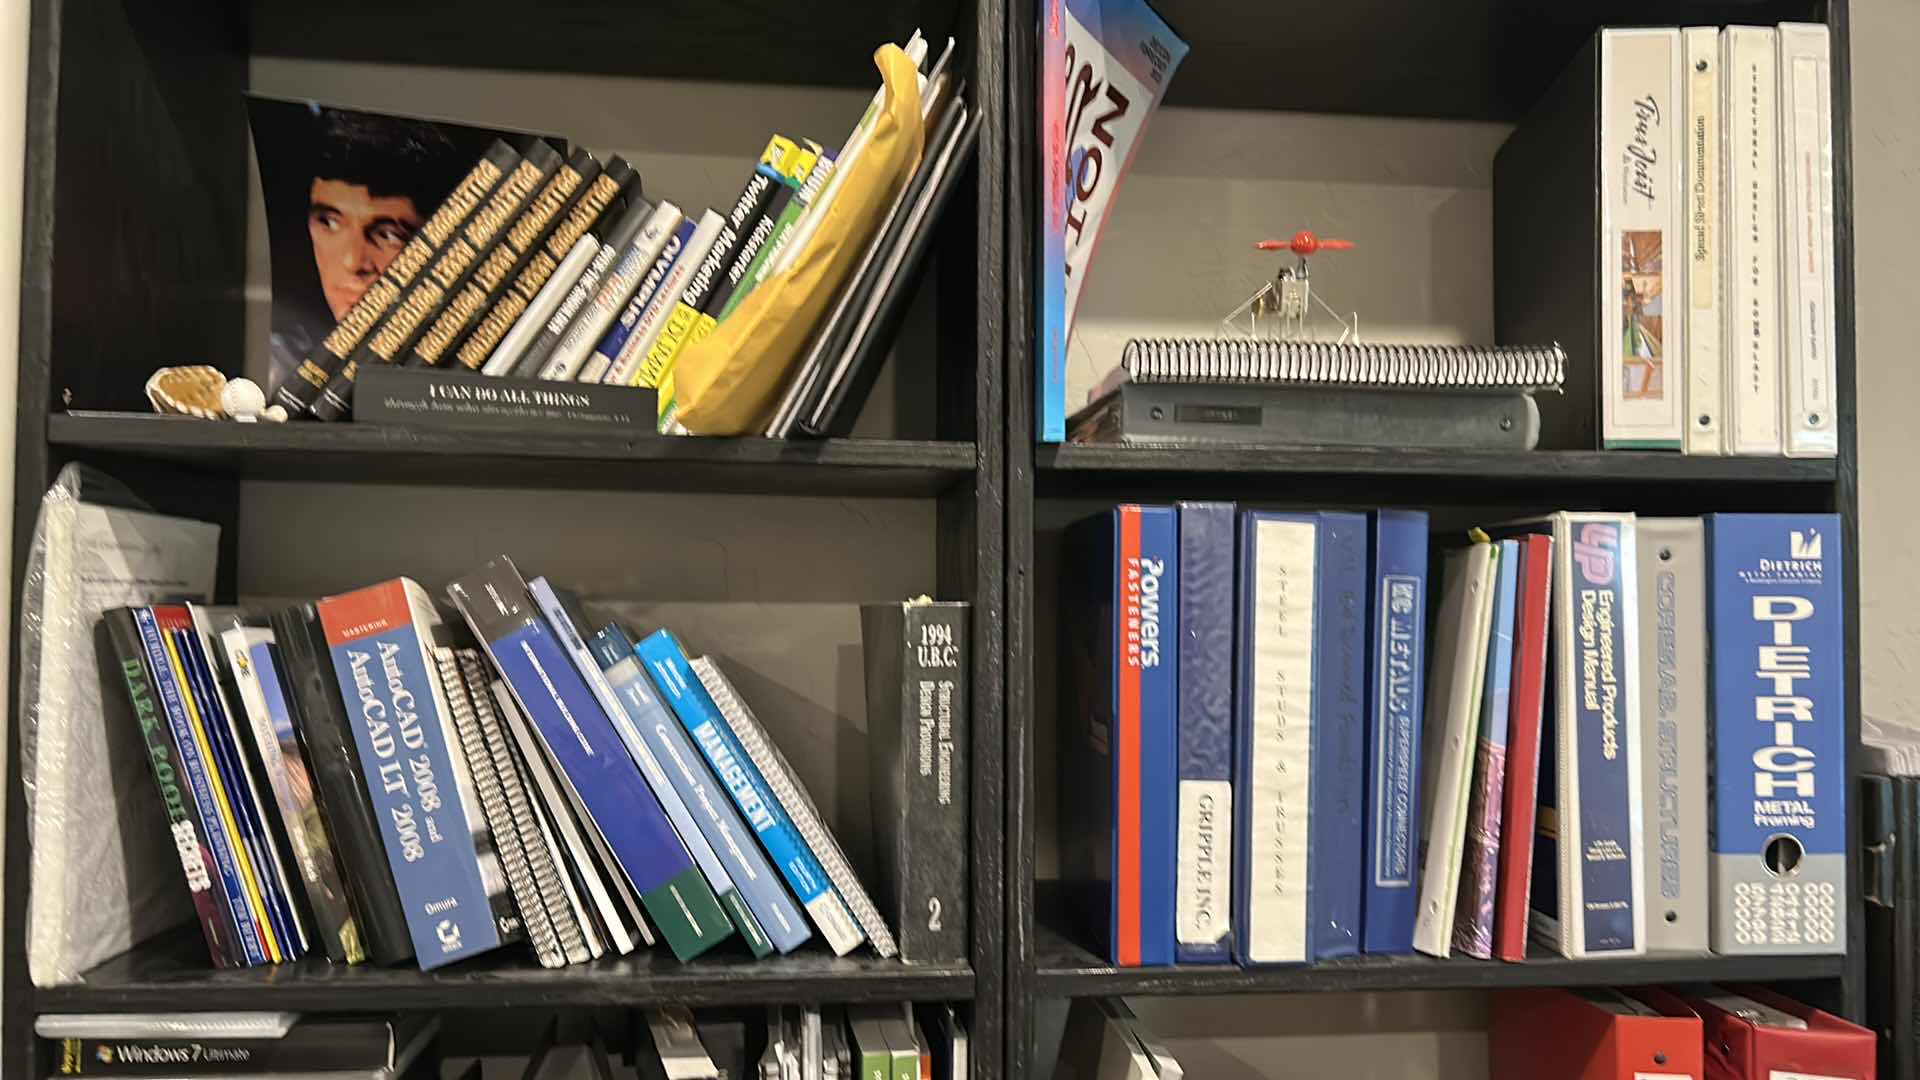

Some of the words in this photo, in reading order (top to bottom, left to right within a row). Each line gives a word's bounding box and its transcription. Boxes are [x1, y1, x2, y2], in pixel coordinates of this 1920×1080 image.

[728, 173, 770, 229] Twitter
[619, 234, 681, 331] OLYMPUS
[681, 227, 738, 306] Marketing
[726, 213, 775, 286] Kickstarter
[429, 384, 436, 398] I
[439, 385, 472, 400] CAN
[475, 388, 497, 401] DO
[501, 389, 530, 404] ALL
[532, 390, 590, 407] THINGS
[1760, 559, 1822, 571] DIETRICH
[921, 624, 952, 646] 1994
[1127, 558, 1139, 667] FASTENERS
[1141, 557, 1164, 669] Powers
[1579, 589, 1597, 646] Design
[1594, 589, 1616, 682] Engineered
[122, 659, 161, 737] DARK
[377, 640, 426, 750] AutoCAD
[1388, 616, 1411, 712] METALS
[1581, 649, 1600, 710] Manual
[1752, 595, 1816, 798] DIETRICH
[347, 649, 397, 759] AutoCAD
[1599, 684, 1619, 759] Products
[378, 765, 408, 796] LT
[409, 753, 442, 812] 2008
[692, 720, 777, 832] MANAGEMENT
[1754, 800, 1814, 814] METAL
[391, 804, 425, 863] 2008
[424, 816, 442, 843] and
[1195, 793, 1215, 883] GRIPPLE
[928, 897, 942, 932] 2
[116, 1044, 189, 1064] Windows
[190, 1044, 202, 1063] 7
